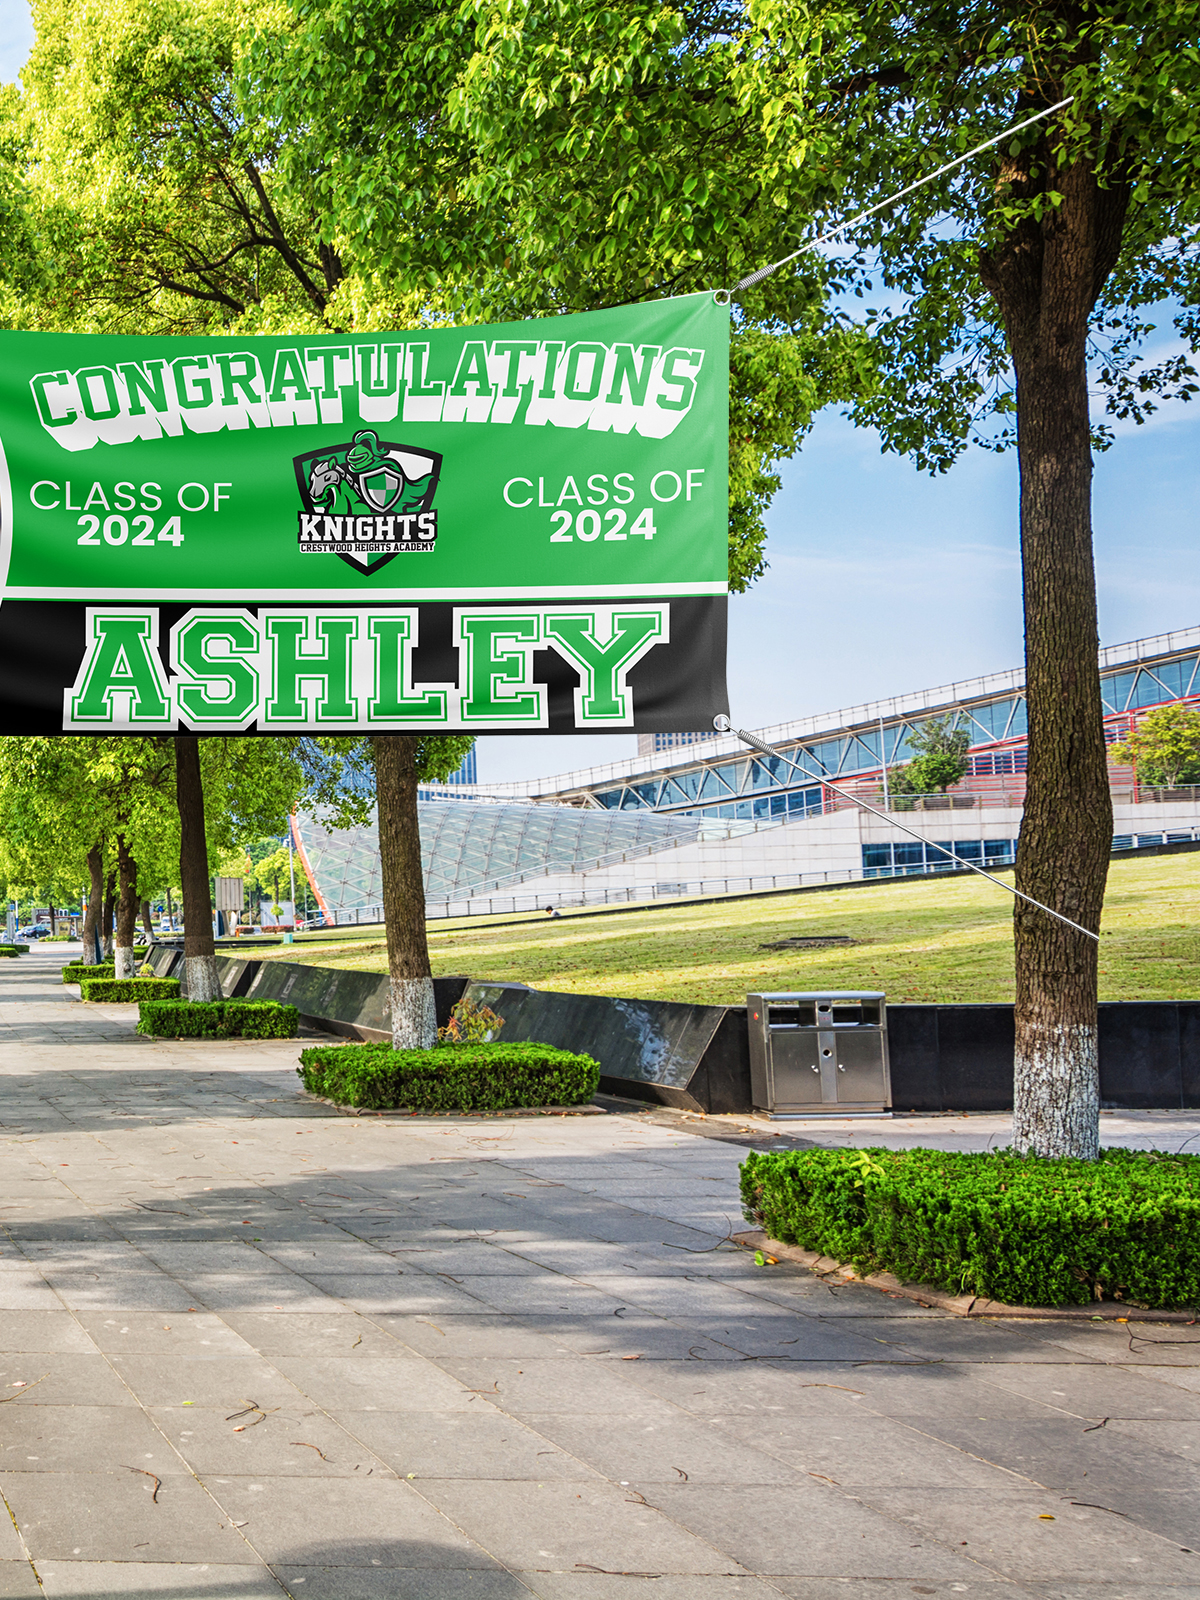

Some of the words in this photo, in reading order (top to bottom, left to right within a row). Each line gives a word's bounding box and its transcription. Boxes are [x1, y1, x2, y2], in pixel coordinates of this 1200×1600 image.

[29, 340, 706, 452] CONGRATULATIONS
[29, 480, 163, 513] CLASS
[177, 482, 234, 512] OF
[502, 472, 636, 508] CLASS
[649, 468, 706, 503] OF
[77, 514, 186, 547] 2024
[299, 511, 436, 542] KNIGHTS
[549, 507, 658, 543] 2024
[300, 543, 353, 553] CRESTWOOD
[354, 543, 392, 553] HEIGHTS
[393, 542, 435, 552] ACADEMY
[63, 602, 671, 732] ASHLEY
